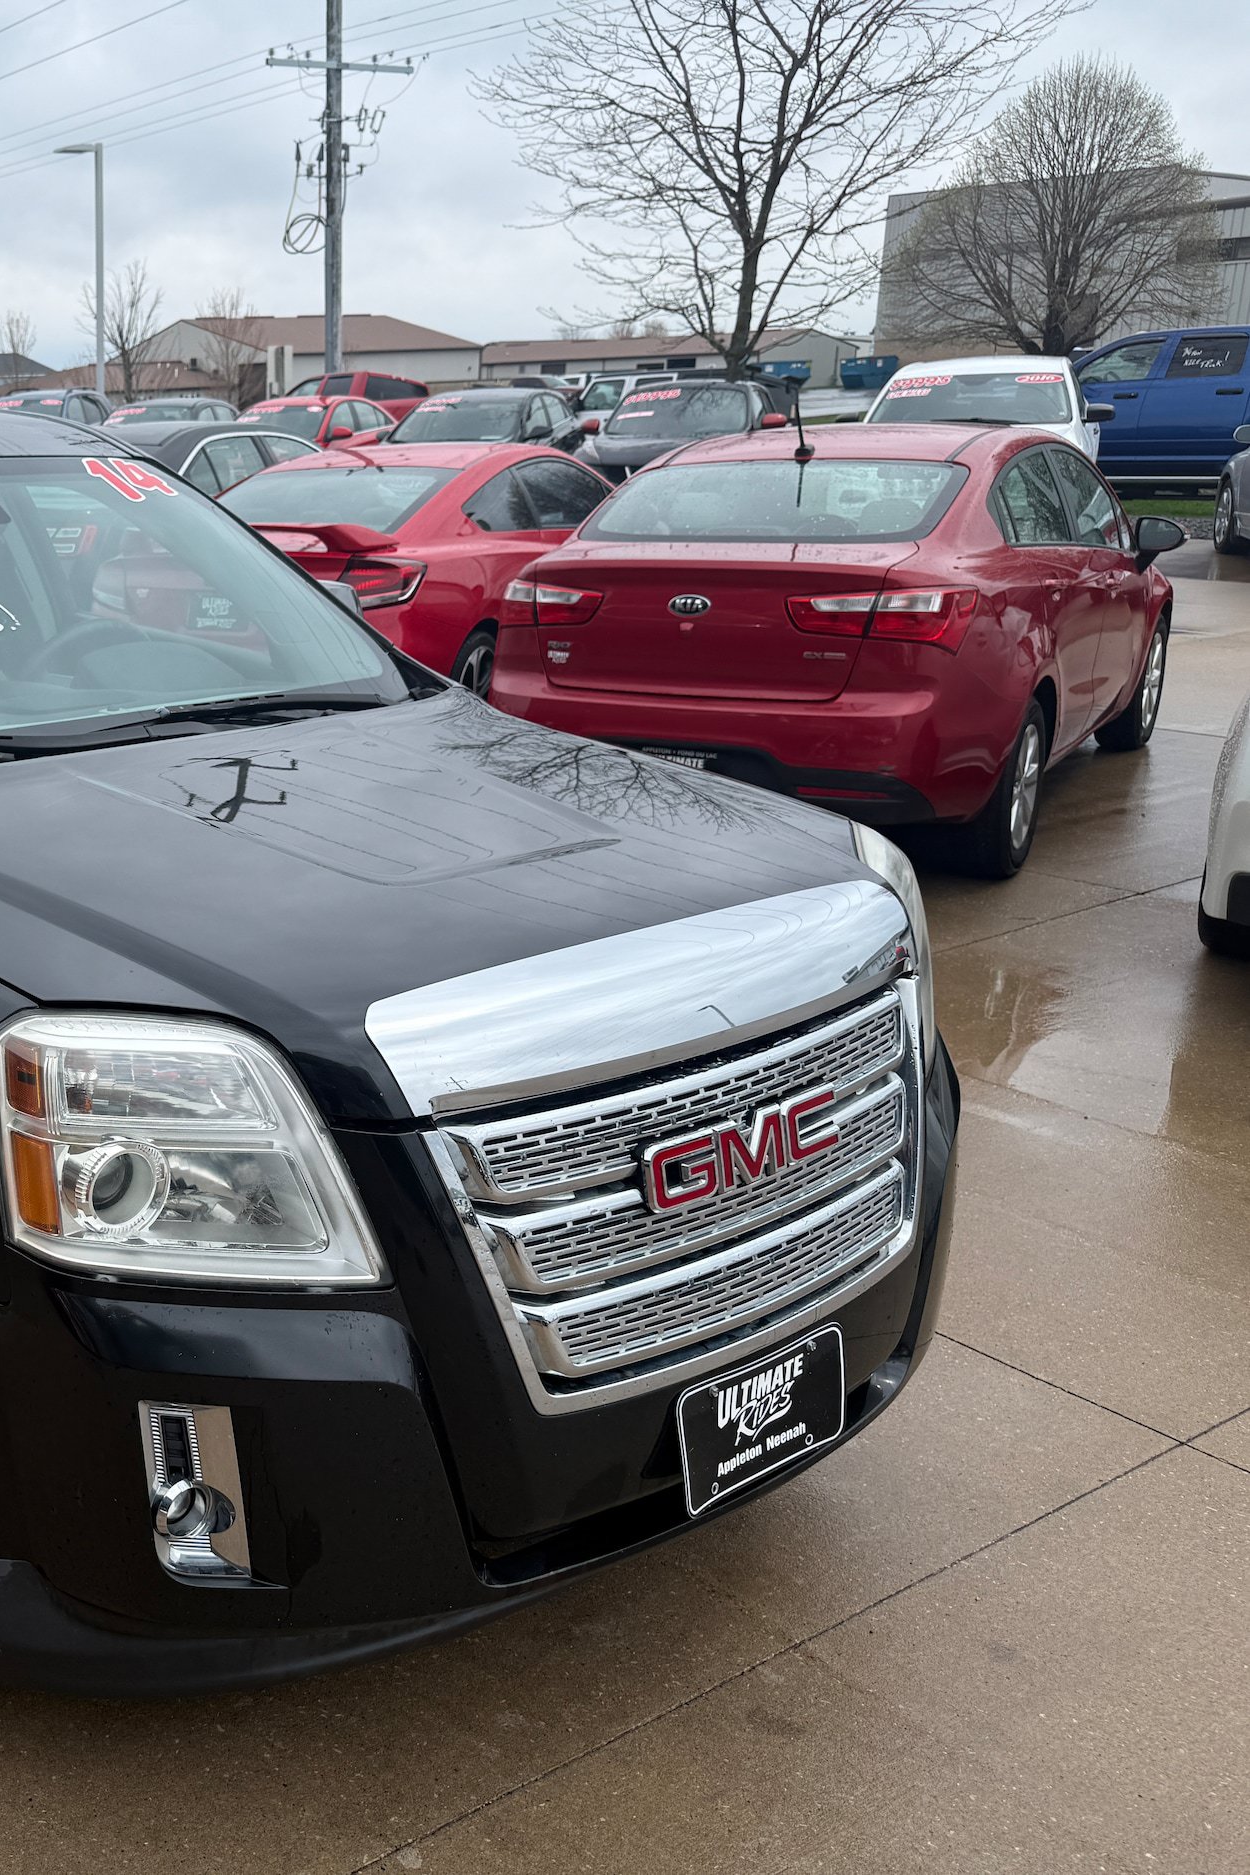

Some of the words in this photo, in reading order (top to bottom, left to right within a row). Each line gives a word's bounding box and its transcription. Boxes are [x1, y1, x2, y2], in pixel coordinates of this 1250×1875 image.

[81, 457, 179, 502] 14
[672, 597, 707, 613] KIA
[643, 1083, 840, 1214] GMC
[717, 1352, 804, 1430] ULTIMATE
[717, 1442, 763, 1478] Appleton
[766, 1421, 807, 1452] Neenah
